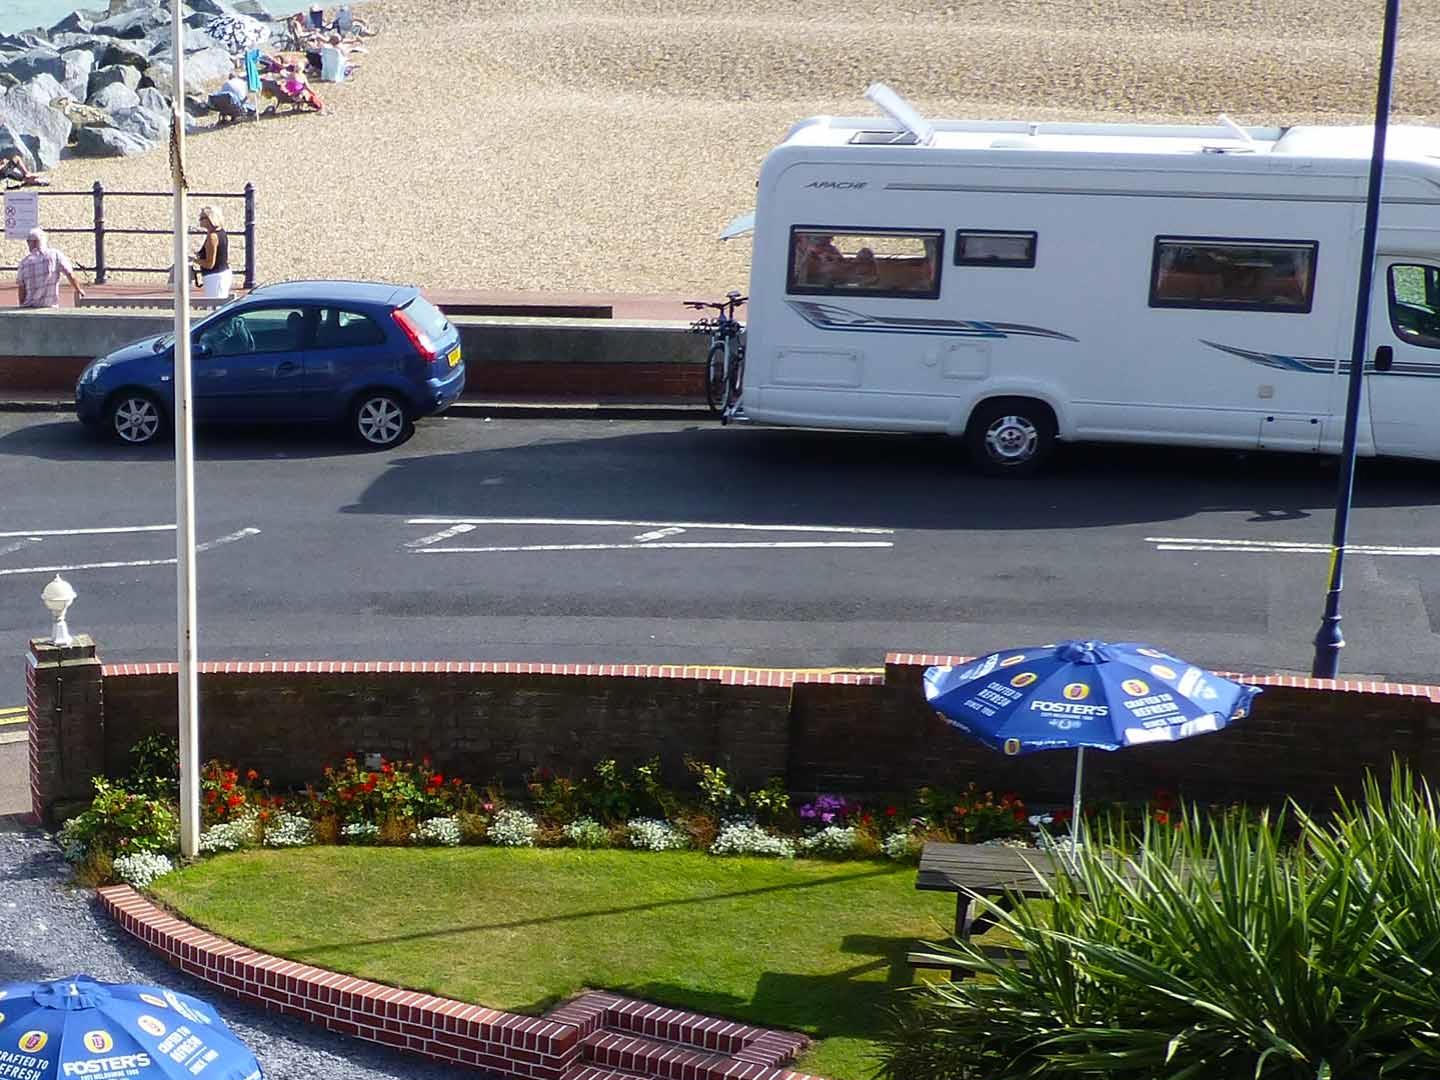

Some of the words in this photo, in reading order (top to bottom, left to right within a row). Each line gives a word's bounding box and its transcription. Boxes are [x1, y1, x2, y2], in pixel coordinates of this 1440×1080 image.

[803, 181, 869, 190] APACHE
[1030, 700, 1109, 717] FOSTER'S
[36, 1058, 50, 1070] TO
[63, 1053, 151, 1077] FOSTER'S
